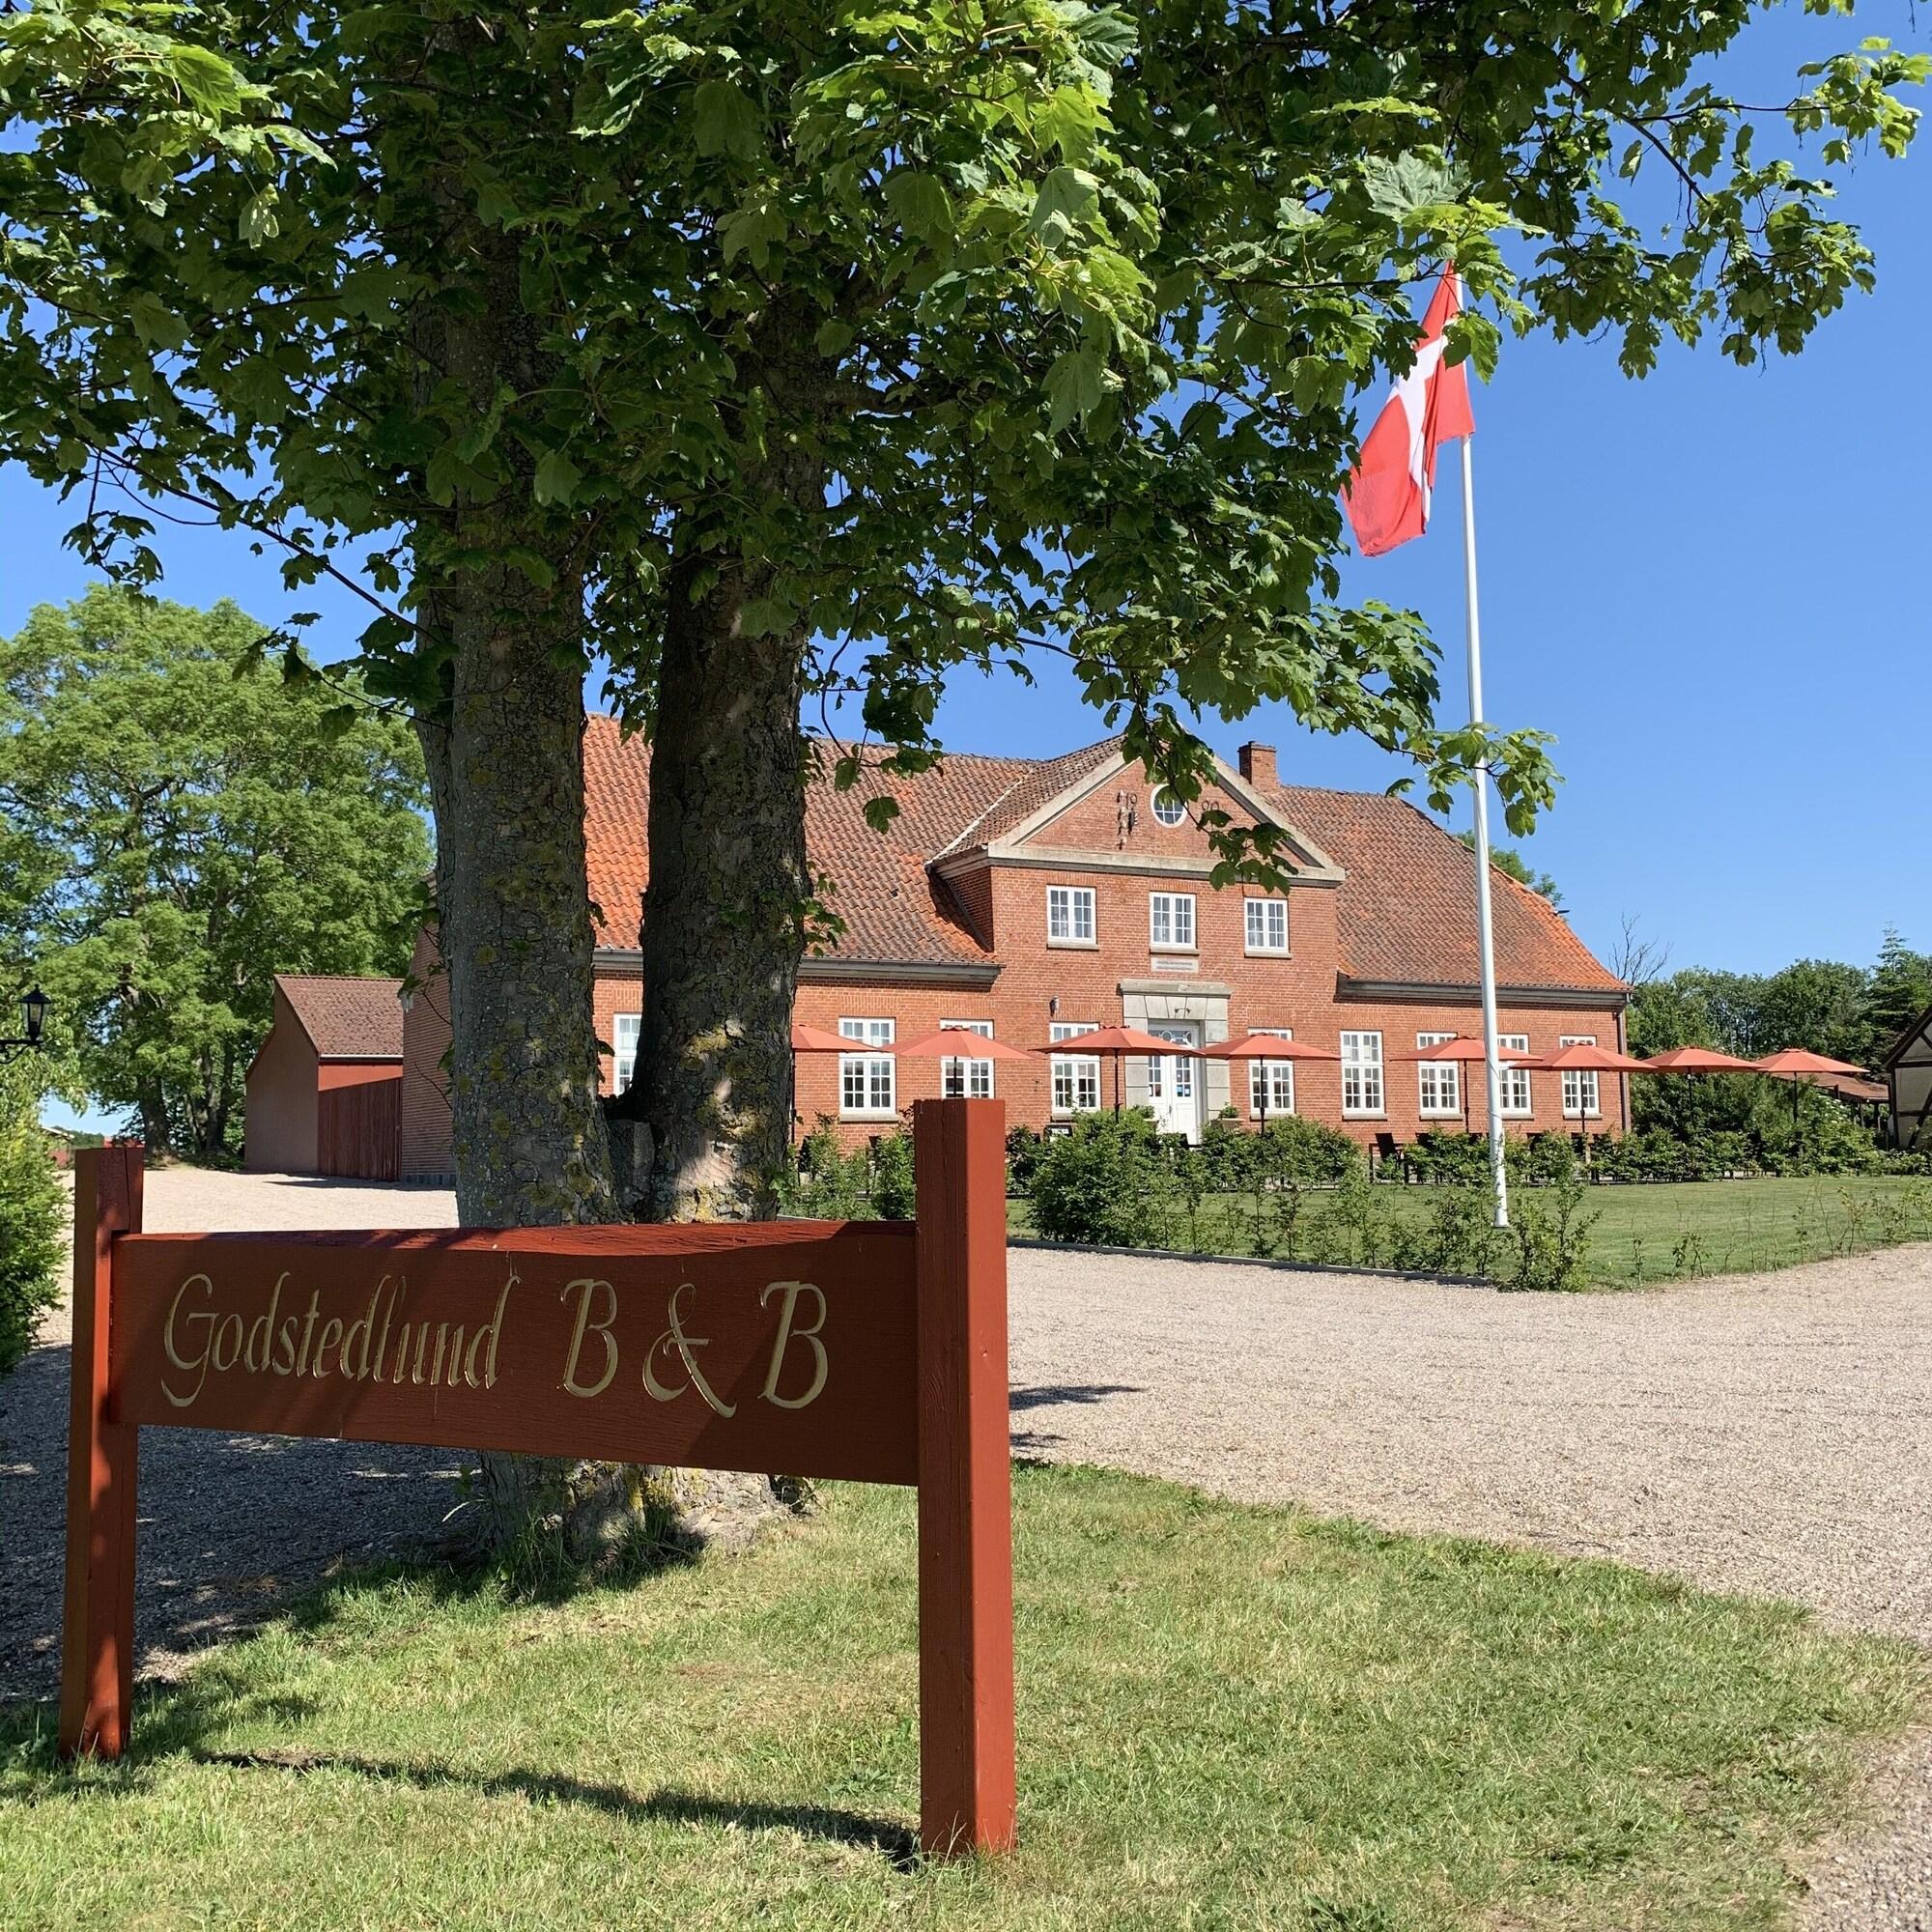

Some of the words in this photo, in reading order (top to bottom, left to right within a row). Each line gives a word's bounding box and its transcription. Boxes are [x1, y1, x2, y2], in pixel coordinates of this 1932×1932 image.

[160, 1270, 523, 1407] Godstedlund
[559, 1278, 619, 1398] B
[641, 1282, 738, 1419] &
[756, 1280, 829, 1409] B
